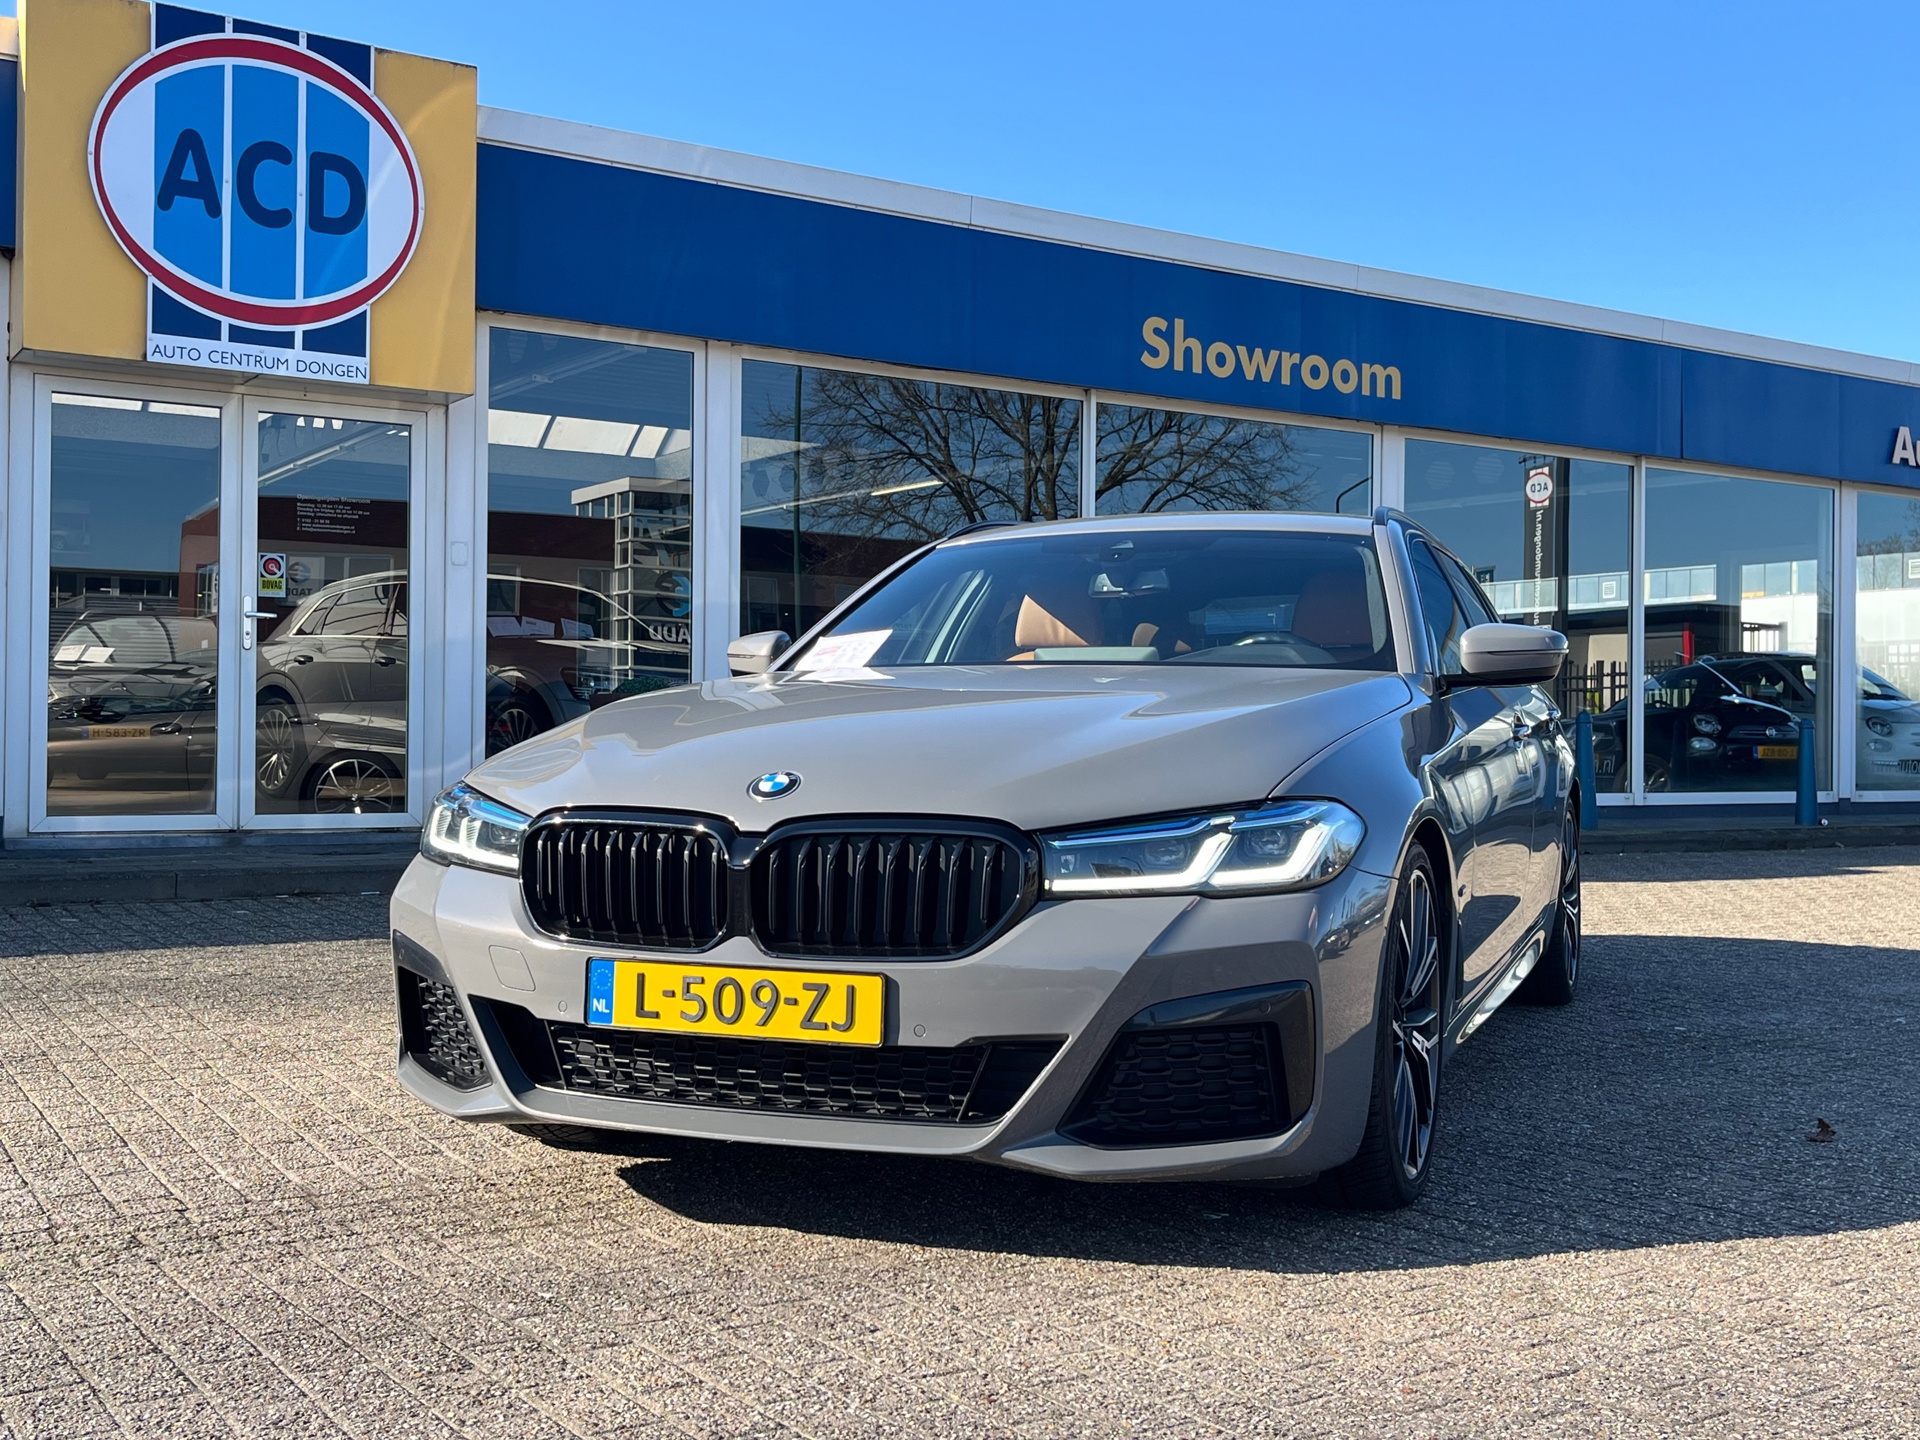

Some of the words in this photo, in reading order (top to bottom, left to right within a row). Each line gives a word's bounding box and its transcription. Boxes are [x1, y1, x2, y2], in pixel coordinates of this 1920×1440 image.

[157, 128, 367, 236] ACD
[151, 344, 202, 361] AUTO
[208, 350, 289, 371] CENTRUM
[296, 359, 367, 380] DONGEN
[1140, 316, 1402, 400] Showroom
[1892, 425, 1920, 467] A
[261, 579, 283, 590] BOVAG
[92, 728, 146, 738] H-583-ZR
[592, 998, 610, 1013] NL
[635, 972, 857, 1032] L-509-ZJ
